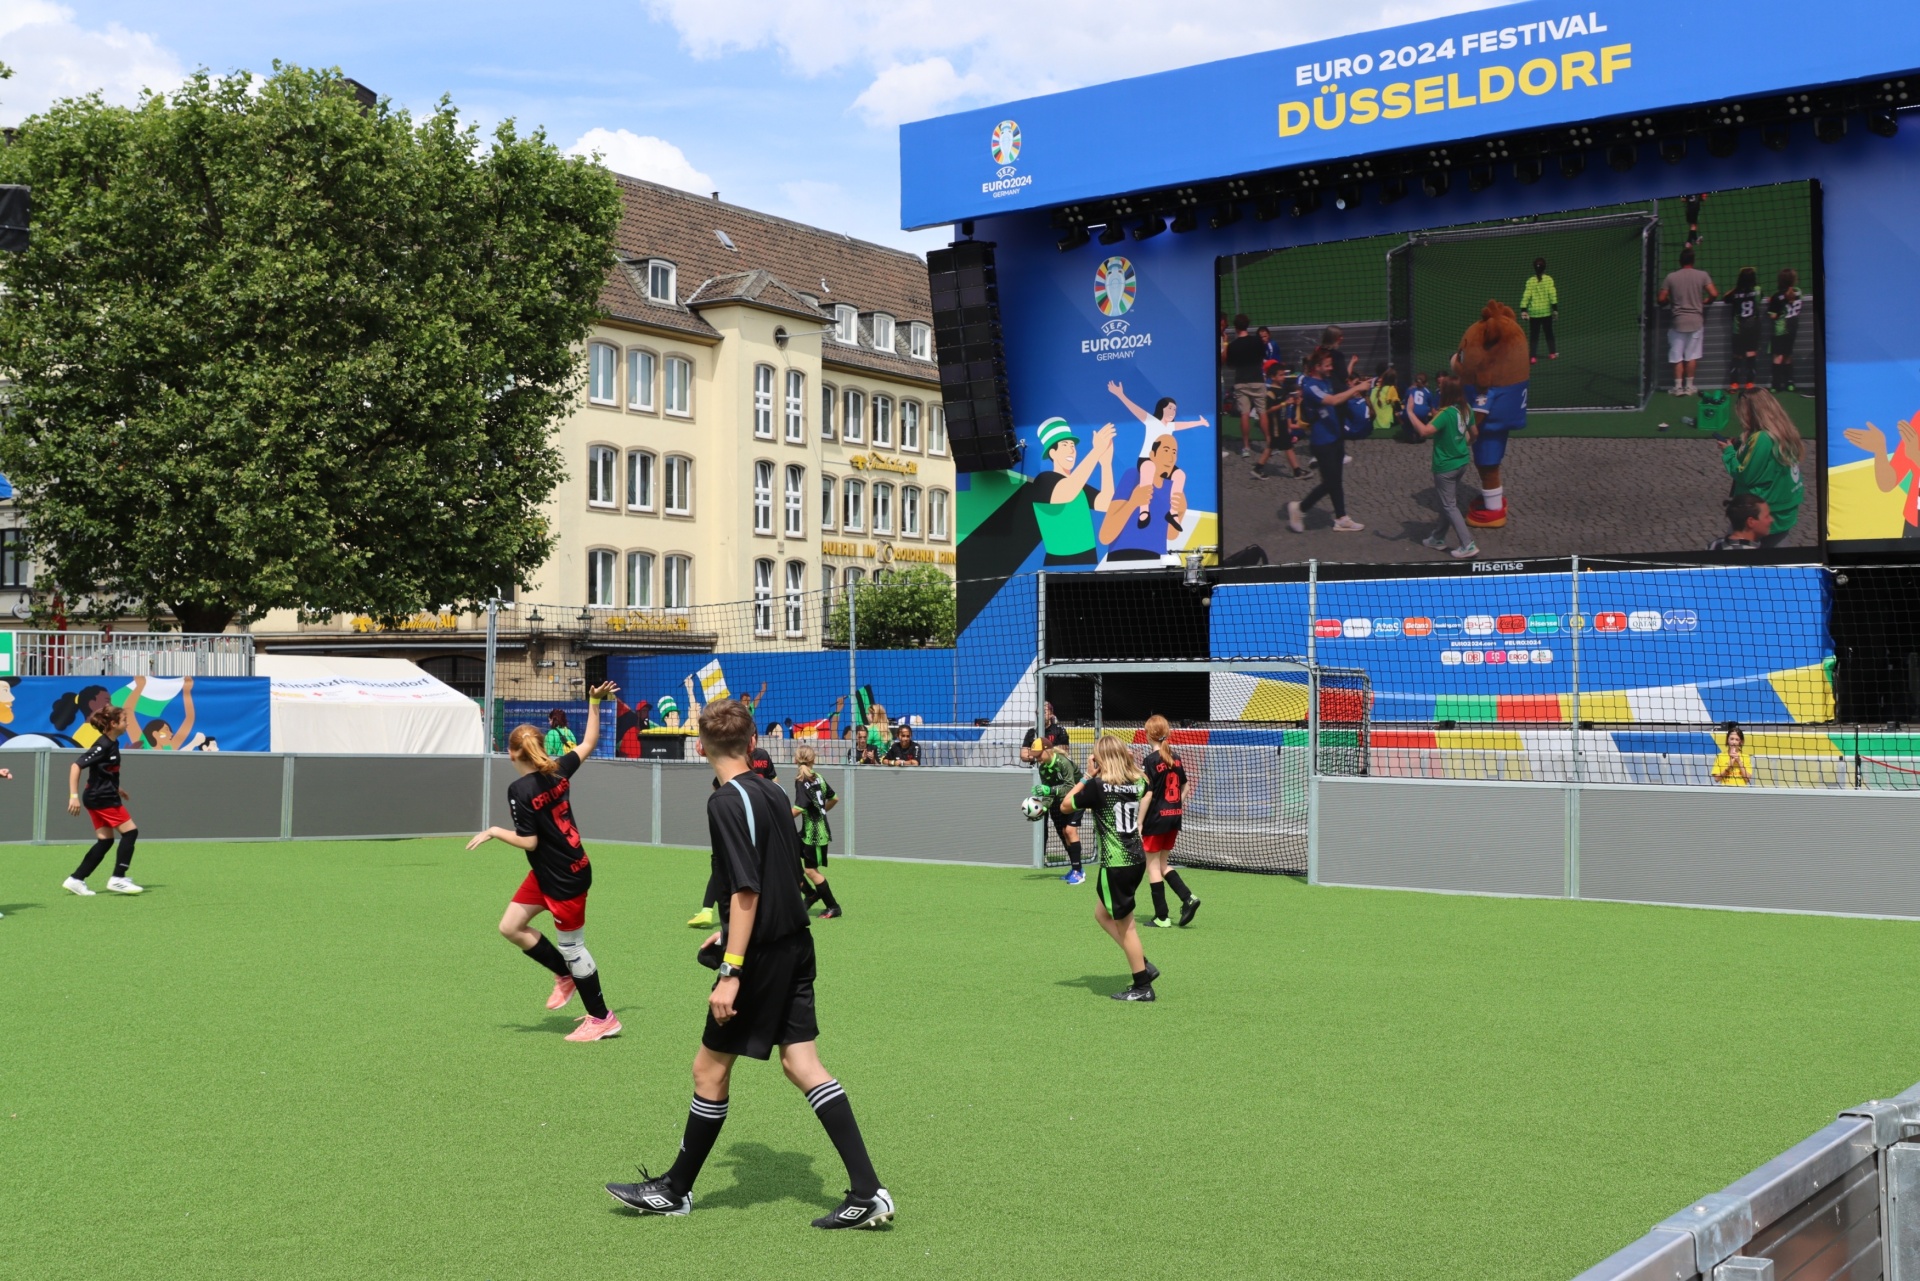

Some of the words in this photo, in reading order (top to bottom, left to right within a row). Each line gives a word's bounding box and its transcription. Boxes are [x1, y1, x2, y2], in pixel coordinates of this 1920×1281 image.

[1296, 54, 1374, 87] EURO
[1379, 38, 1456, 71] 2024
[1462, 11, 1608, 57] FESTIVAL
[1278, 43, 1632, 138] DÜSSELDORF
[992, 188, 1021, 198] GERMANY
[1102, 321, 1129, 335] UEFA
[1096, 350, 1135, 362] GERMANY
[1413, 390, 1424, 405] 6
[1472, 562, 1524, 572] Hisense
[439, 613, 457, 629] Alt
[1530, 620, 1558, 628] Hisense
[1664, 615, 1697, 625] vivo
[1508, 653, 1529, 661] ERGO
[1164, 771, 1181, 804] 8
[551, 800, 580, 849] 5
[1112, 801, 1140, 834] 10
